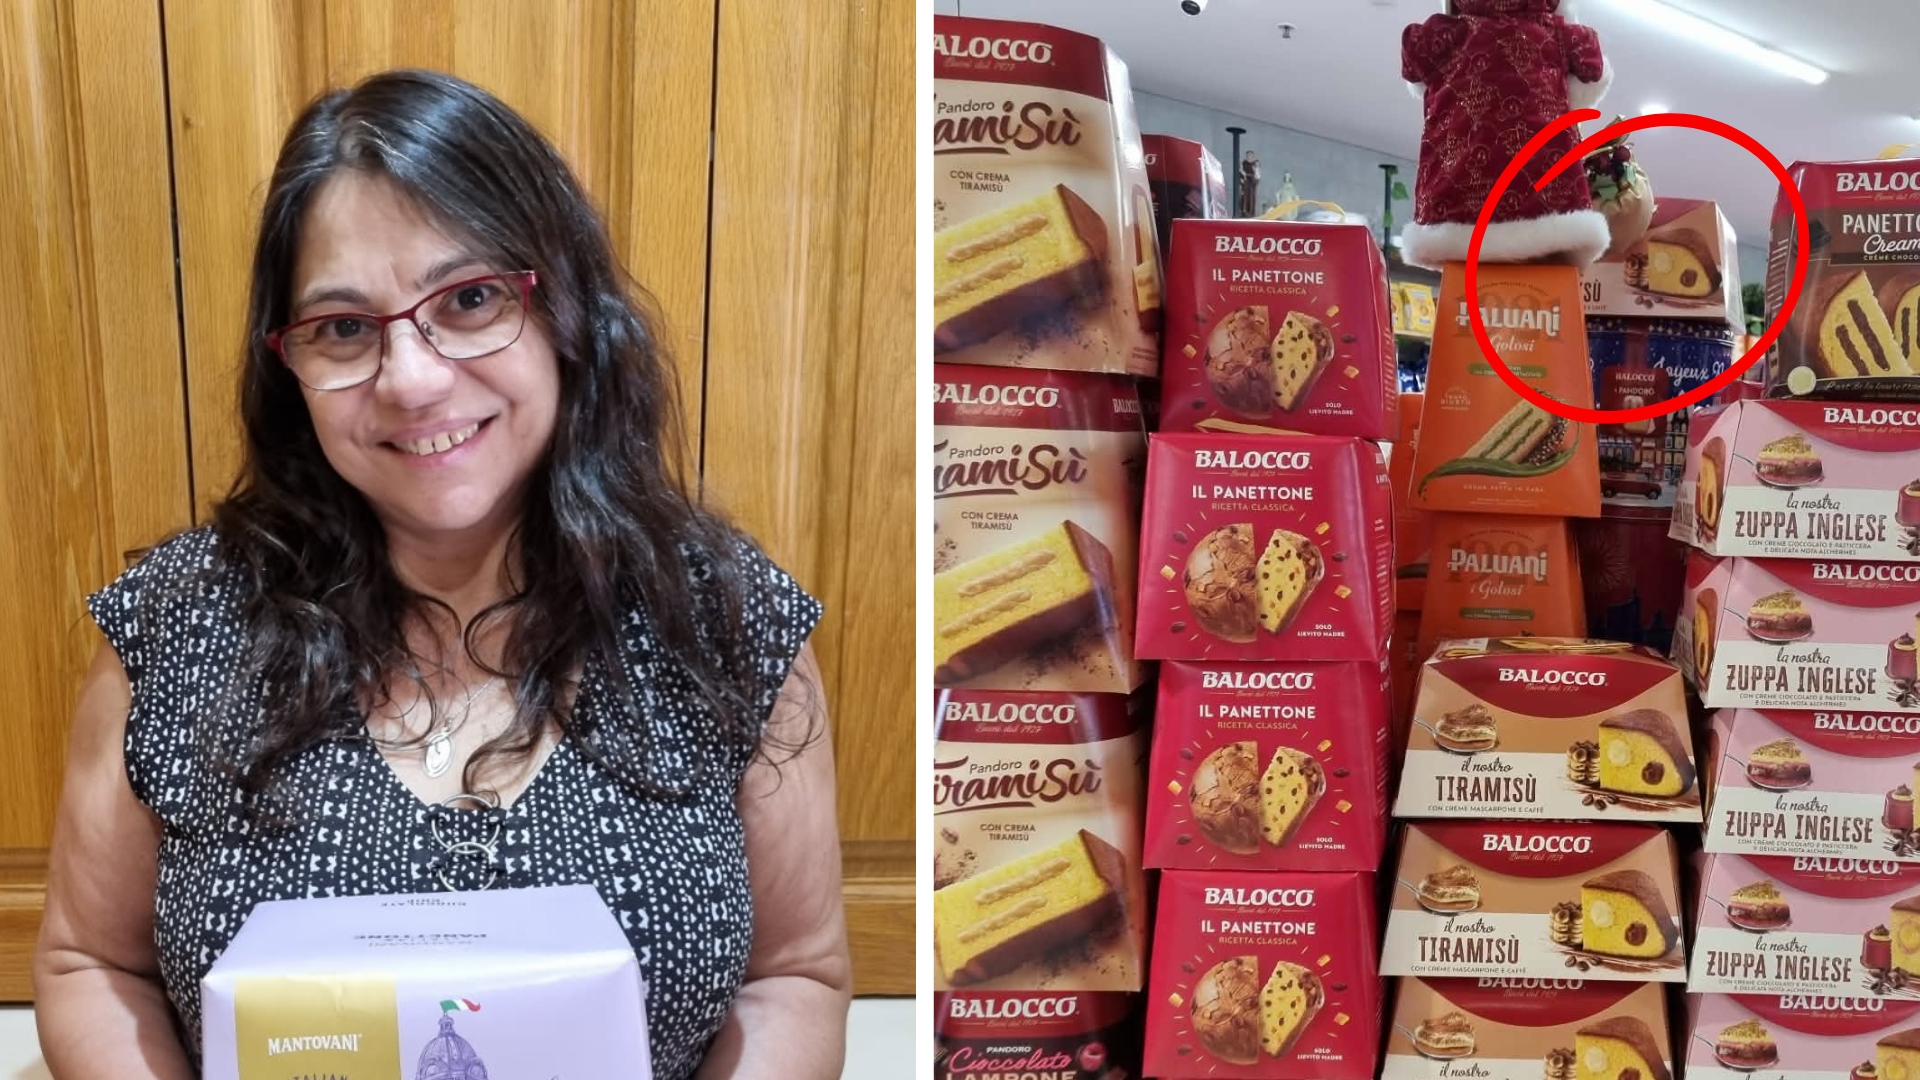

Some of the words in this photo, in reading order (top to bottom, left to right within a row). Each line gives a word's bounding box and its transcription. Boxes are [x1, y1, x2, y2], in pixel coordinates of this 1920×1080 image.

[937, 99, 995, 114] Pandoro
[950, 170, 973, 180] CON
[976, 173, 1010, 183] CREMA
[960, 181, 1003, 193] TIRAMISÙ
[1215, 236, 1321, 255] BALOCCO
[1213, 268, 1226, 281] IL
[1232, 269, 1324, 284] PANETTONE
[1230, 285, 1264, 294] RICETTA
[1267, 286, 1306, 295] CLASSICA
[1615, 373, 1655, 382] BALOCCO
[1824, 407, 1920, 426] BALOCC
[950, 443, 1004, 459] Pandoro
[1195, 450, 1311, 470] BALOCCO
[1192, 484, 1208, 499] IL
[1214, 485, 1313, 500] PANETTONE
[1211, 502, 1249, 511] RICETTA
[1251, 503, 1294, 513] CLASSICA
[1786, 492, 1798, 508] la
[1801, 493, 1841, 510] nostra
[961, 511, 984, 520] CON
[986, 512, 1019, 521] CREMA
[971, 520, 1012, 531] TIRAMISÙ
[1735, 511, 1798, 538] ZUPPA
[1807, 513, 1887, 541] INGLESE
[1812, 563, 1920, 582] BALOCCO
[1478, 577, 1524, 600] Golosi
[1776, 647, 1789, 662] la
[1791, 648, 1831, 664] nostra
[1203, 671, 1314, 690] BALOCCO
[1499, 668, 1606, 686] BALOCCO
[1726, 665, 1789, 691] ZUPPA
[1797, 667, 1877, 694] INGLESE
[944, 701, 1076, 724] BALOCCO
[1199, 705, 1214, 718] IL
[1220, 705, 1316, 719] PANETTONE
[1217, 721, 1253, 729] RICETTA
[1255, 722, 1297, 730] CLASSICA
[1814, 713, 1920, 733] BALOCCO
[969, 760, 1022, 774] Pandoro
[1461, 757, 1472, 772] il
[1473, 757, 1513, 772] nostro
[1435, 773, 1536, 802] TIRAMISÙ
[1775, 795, 1786, 811] la
[1789, 796, 1829, 813] nostra
[980, 824, 1001, 832] CON
[1004, 824, 1036, 832] CREMA
[1725, 811, 1787, 839] ZUPPA
[1794, 814, 1874, 843] INGLESE
[1483, 834, 1592, 853] BALOCCO
[1794, 857, 1899, 875] BALOCCO
[1204, 888, 1315, 906] BALOCCO
[1201, 920, 1215, 933] IL
[1221, 921, 1316, 935] PANETTONE
[1444, 917, 1455, 933] il
[1455, 917, 1496, 933] nostro
[1219, 936, 1253, 945] RICETTA
[1256, 937, 1298, 946] CLASSICA
[1418, 935, 1519, 964] TIRAMISÙ
[1755, 936, 1766, 951] la
[1769, 937, 1808, 954] nostra
[1706, 951, 1767, 979] ZUPPA
[1774, 955, 1852, 983] INGLESE
[1478, 977, 1584, 989] BALOCCO
[950, 996, 1077, 1018] BALOCCO
[1779, 996, 1884, 1012] BALOCCO
[267, 1033, 359, 1056] MANTOVANI
[986, 1046, 1031, 1054] PANDORO
[949, 1047, 1073, 1073] Cioccolato
[1440, 1062, 1449, 1077] il
[1450, 1063, 1491, 1077] nostro
